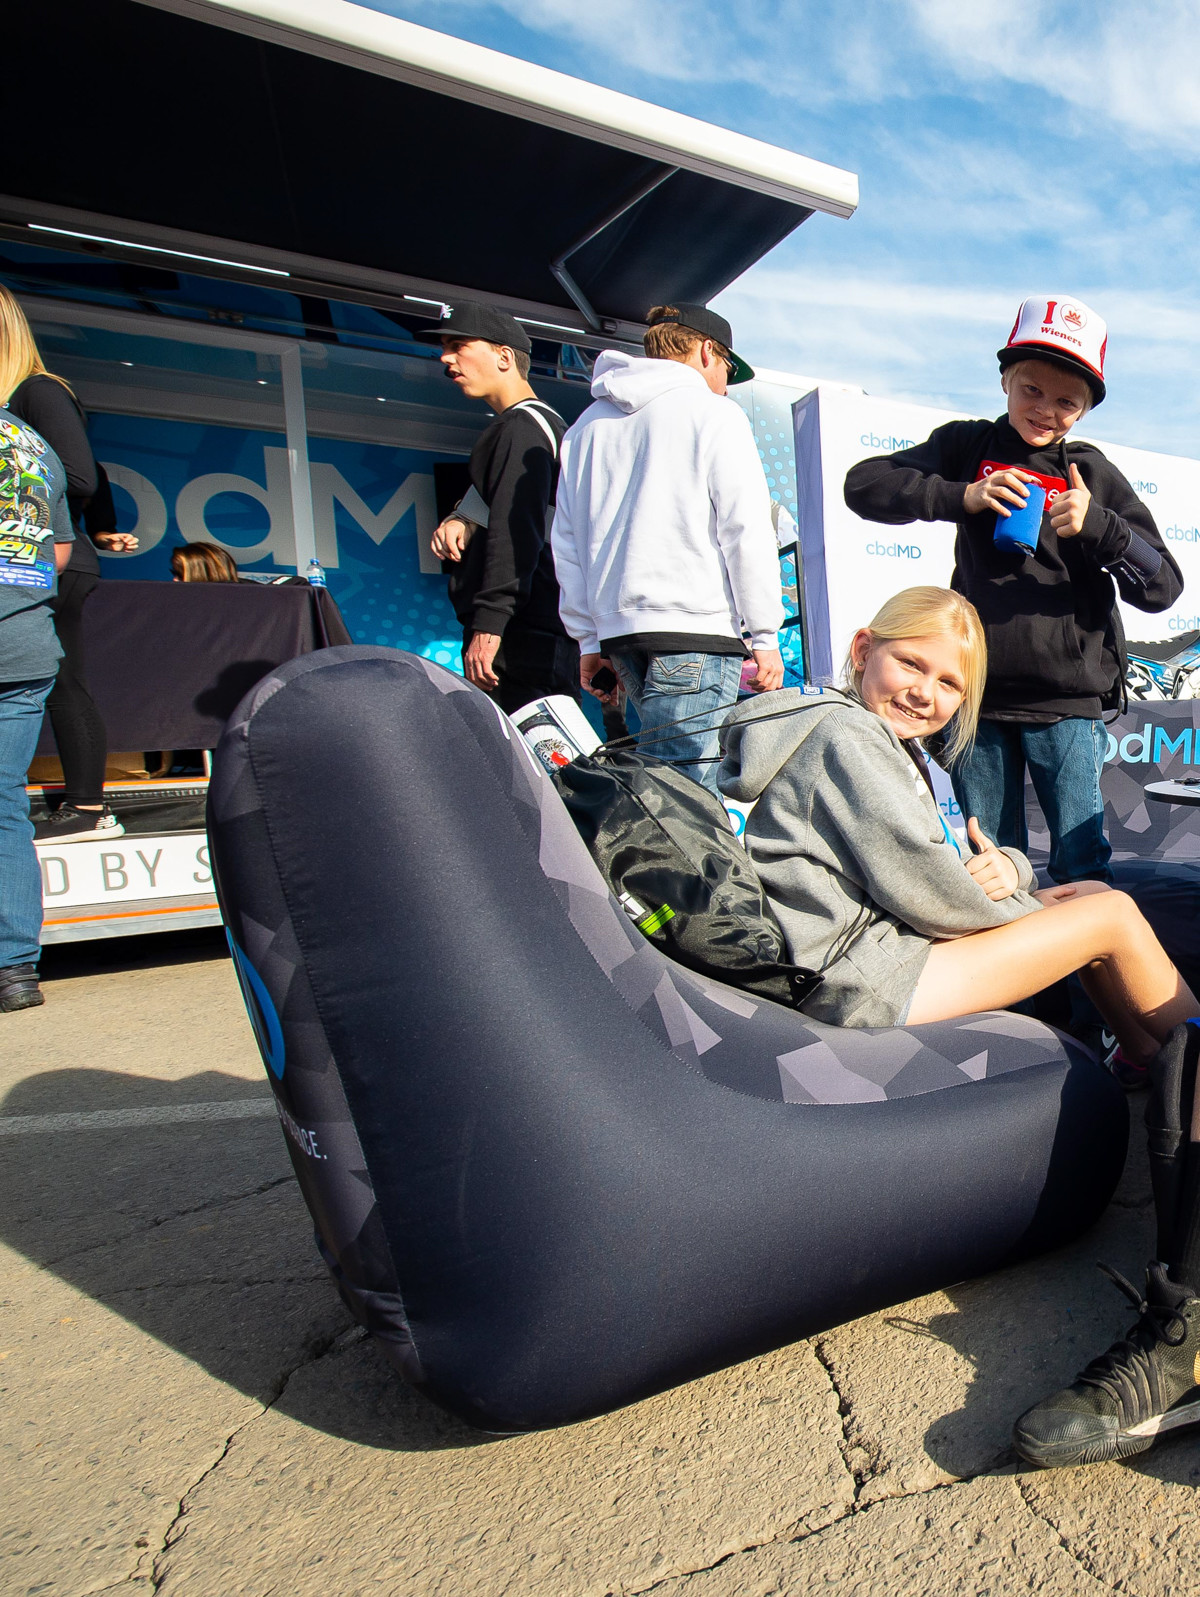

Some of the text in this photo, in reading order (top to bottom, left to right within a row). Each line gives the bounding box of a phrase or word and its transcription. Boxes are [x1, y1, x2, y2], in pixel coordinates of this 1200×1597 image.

[1043, 301, 1057, 324] I
[1041, 326, 1082, 347] Wieners
[1131, 480, 1158, 494] dMD
[866, 541, 921, 559] cbdMD
[100, 848, 163, 892] BY
